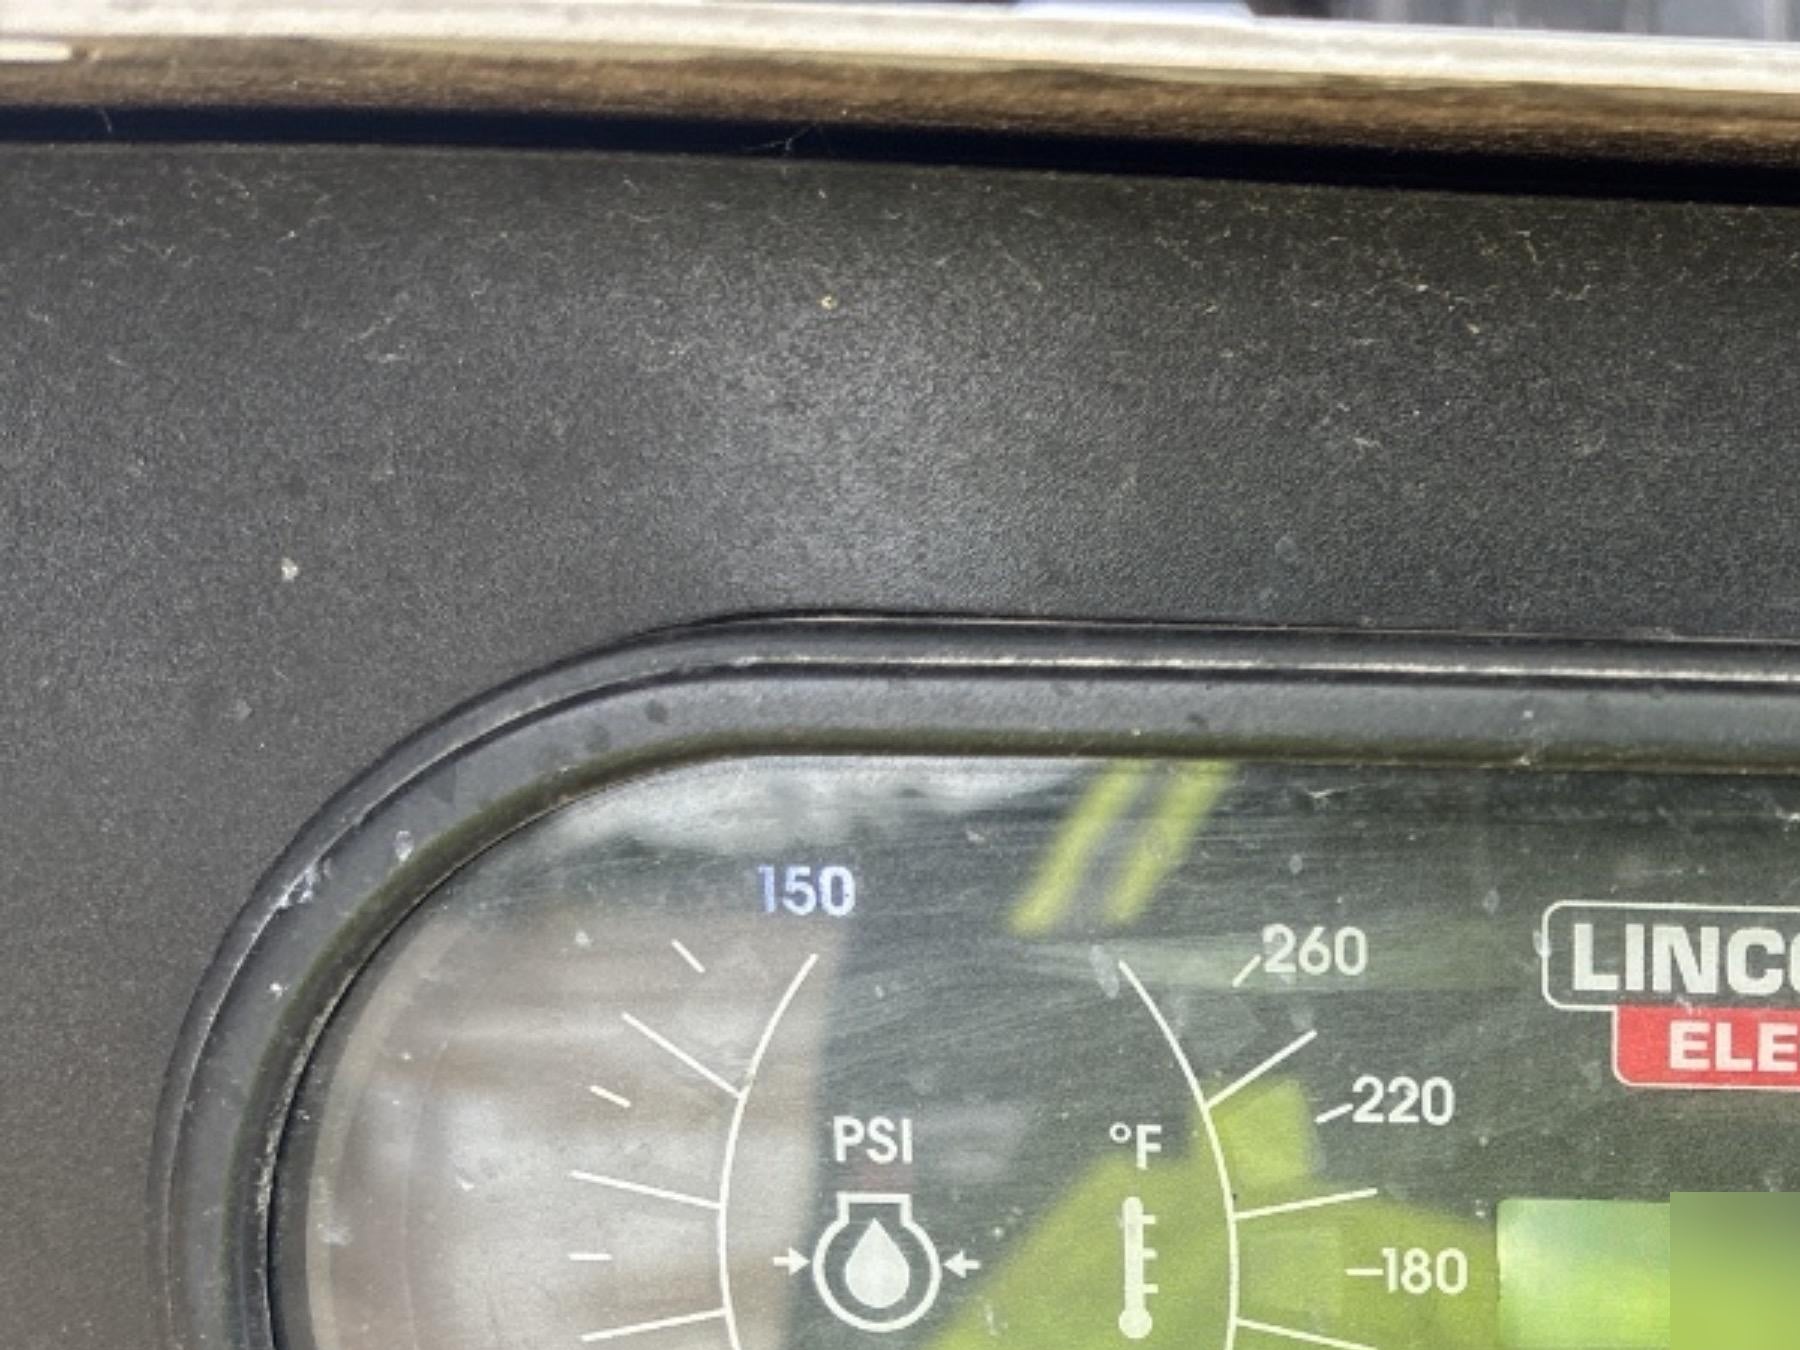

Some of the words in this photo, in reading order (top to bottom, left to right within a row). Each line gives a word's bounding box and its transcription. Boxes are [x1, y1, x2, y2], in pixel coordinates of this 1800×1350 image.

[759, 866, 856, 916] 150
[1262, 925, 1368, 976] 260
[1352, 1076, 1456, 1125] 220
[833, 1117, 913, 1164] PSI
[1109, 1123, 1163, 1169] °F
[1381, 1248, 1468, 1296] 180
